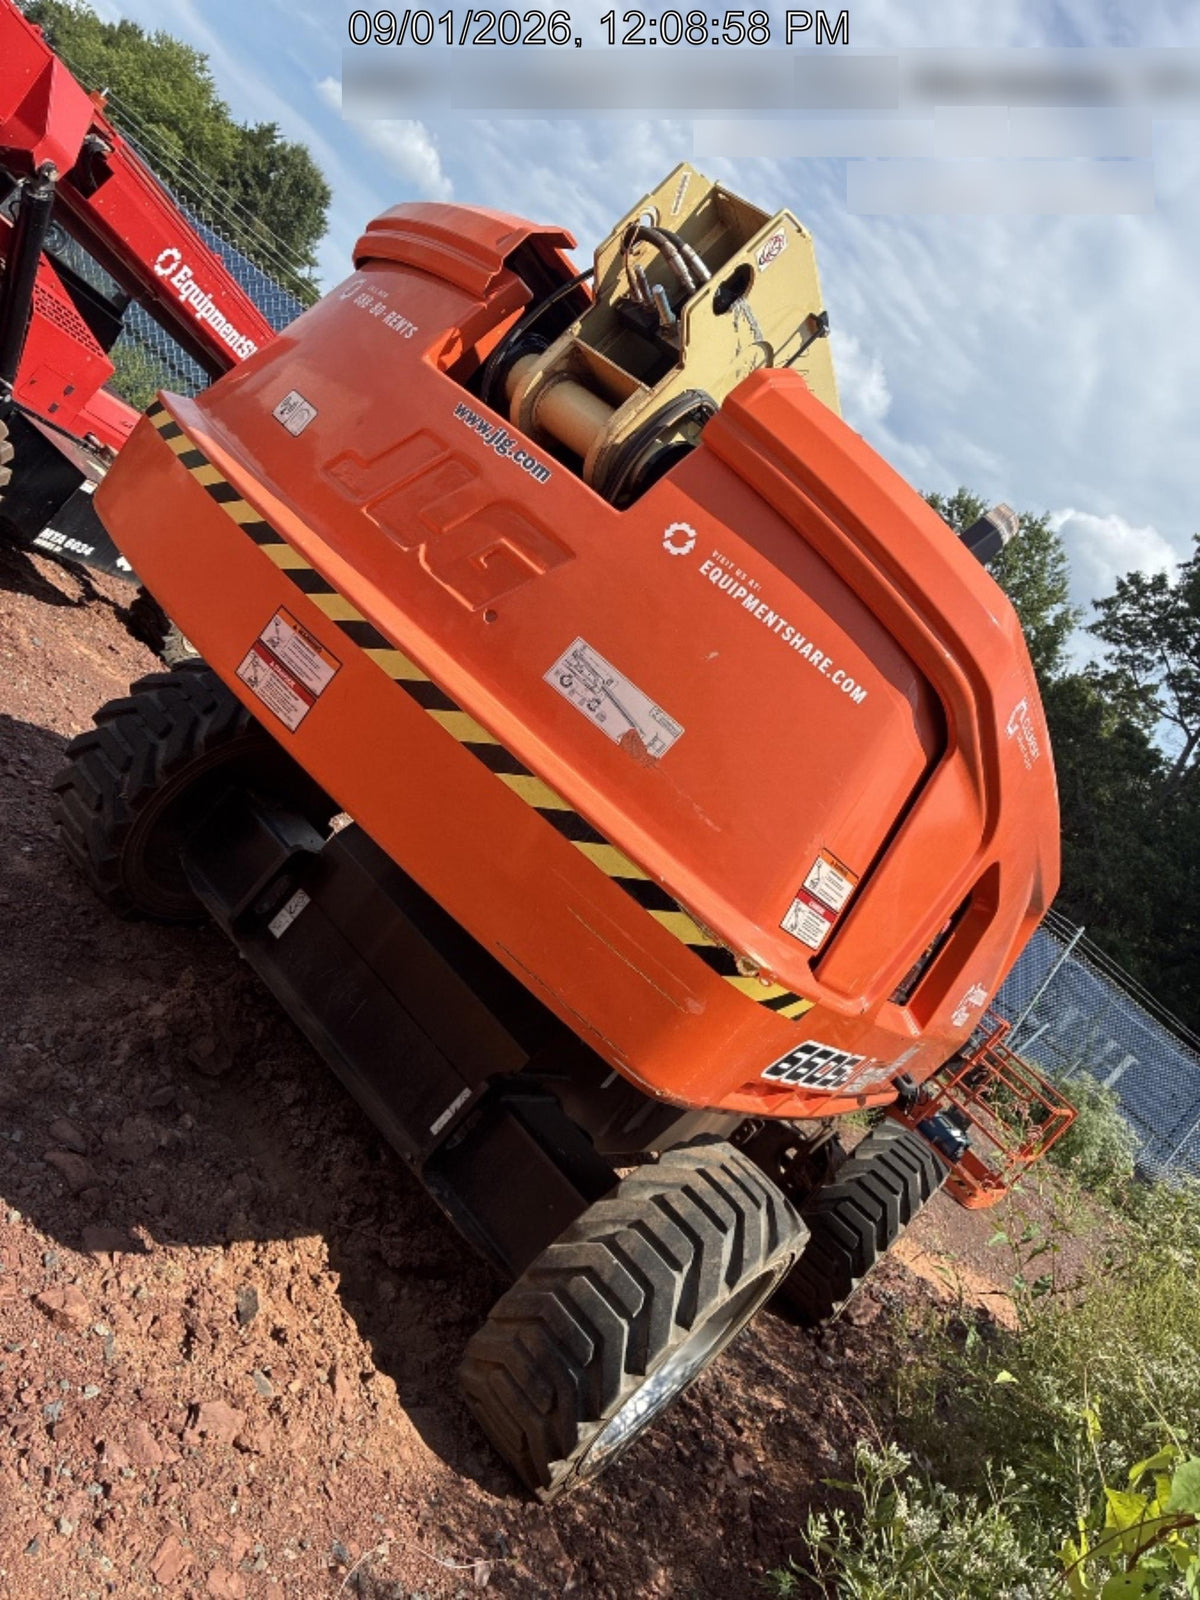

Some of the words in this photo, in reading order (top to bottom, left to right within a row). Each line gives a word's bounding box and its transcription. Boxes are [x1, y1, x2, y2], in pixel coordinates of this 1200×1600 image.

[170, 264, 258, 361] EquipmentS
[453, 401, 552, 484] www.jlg.com
[318, 427, 577, 612] JLG
[698, 560, 867, 704] EQUIPMENTSHARE.COM
